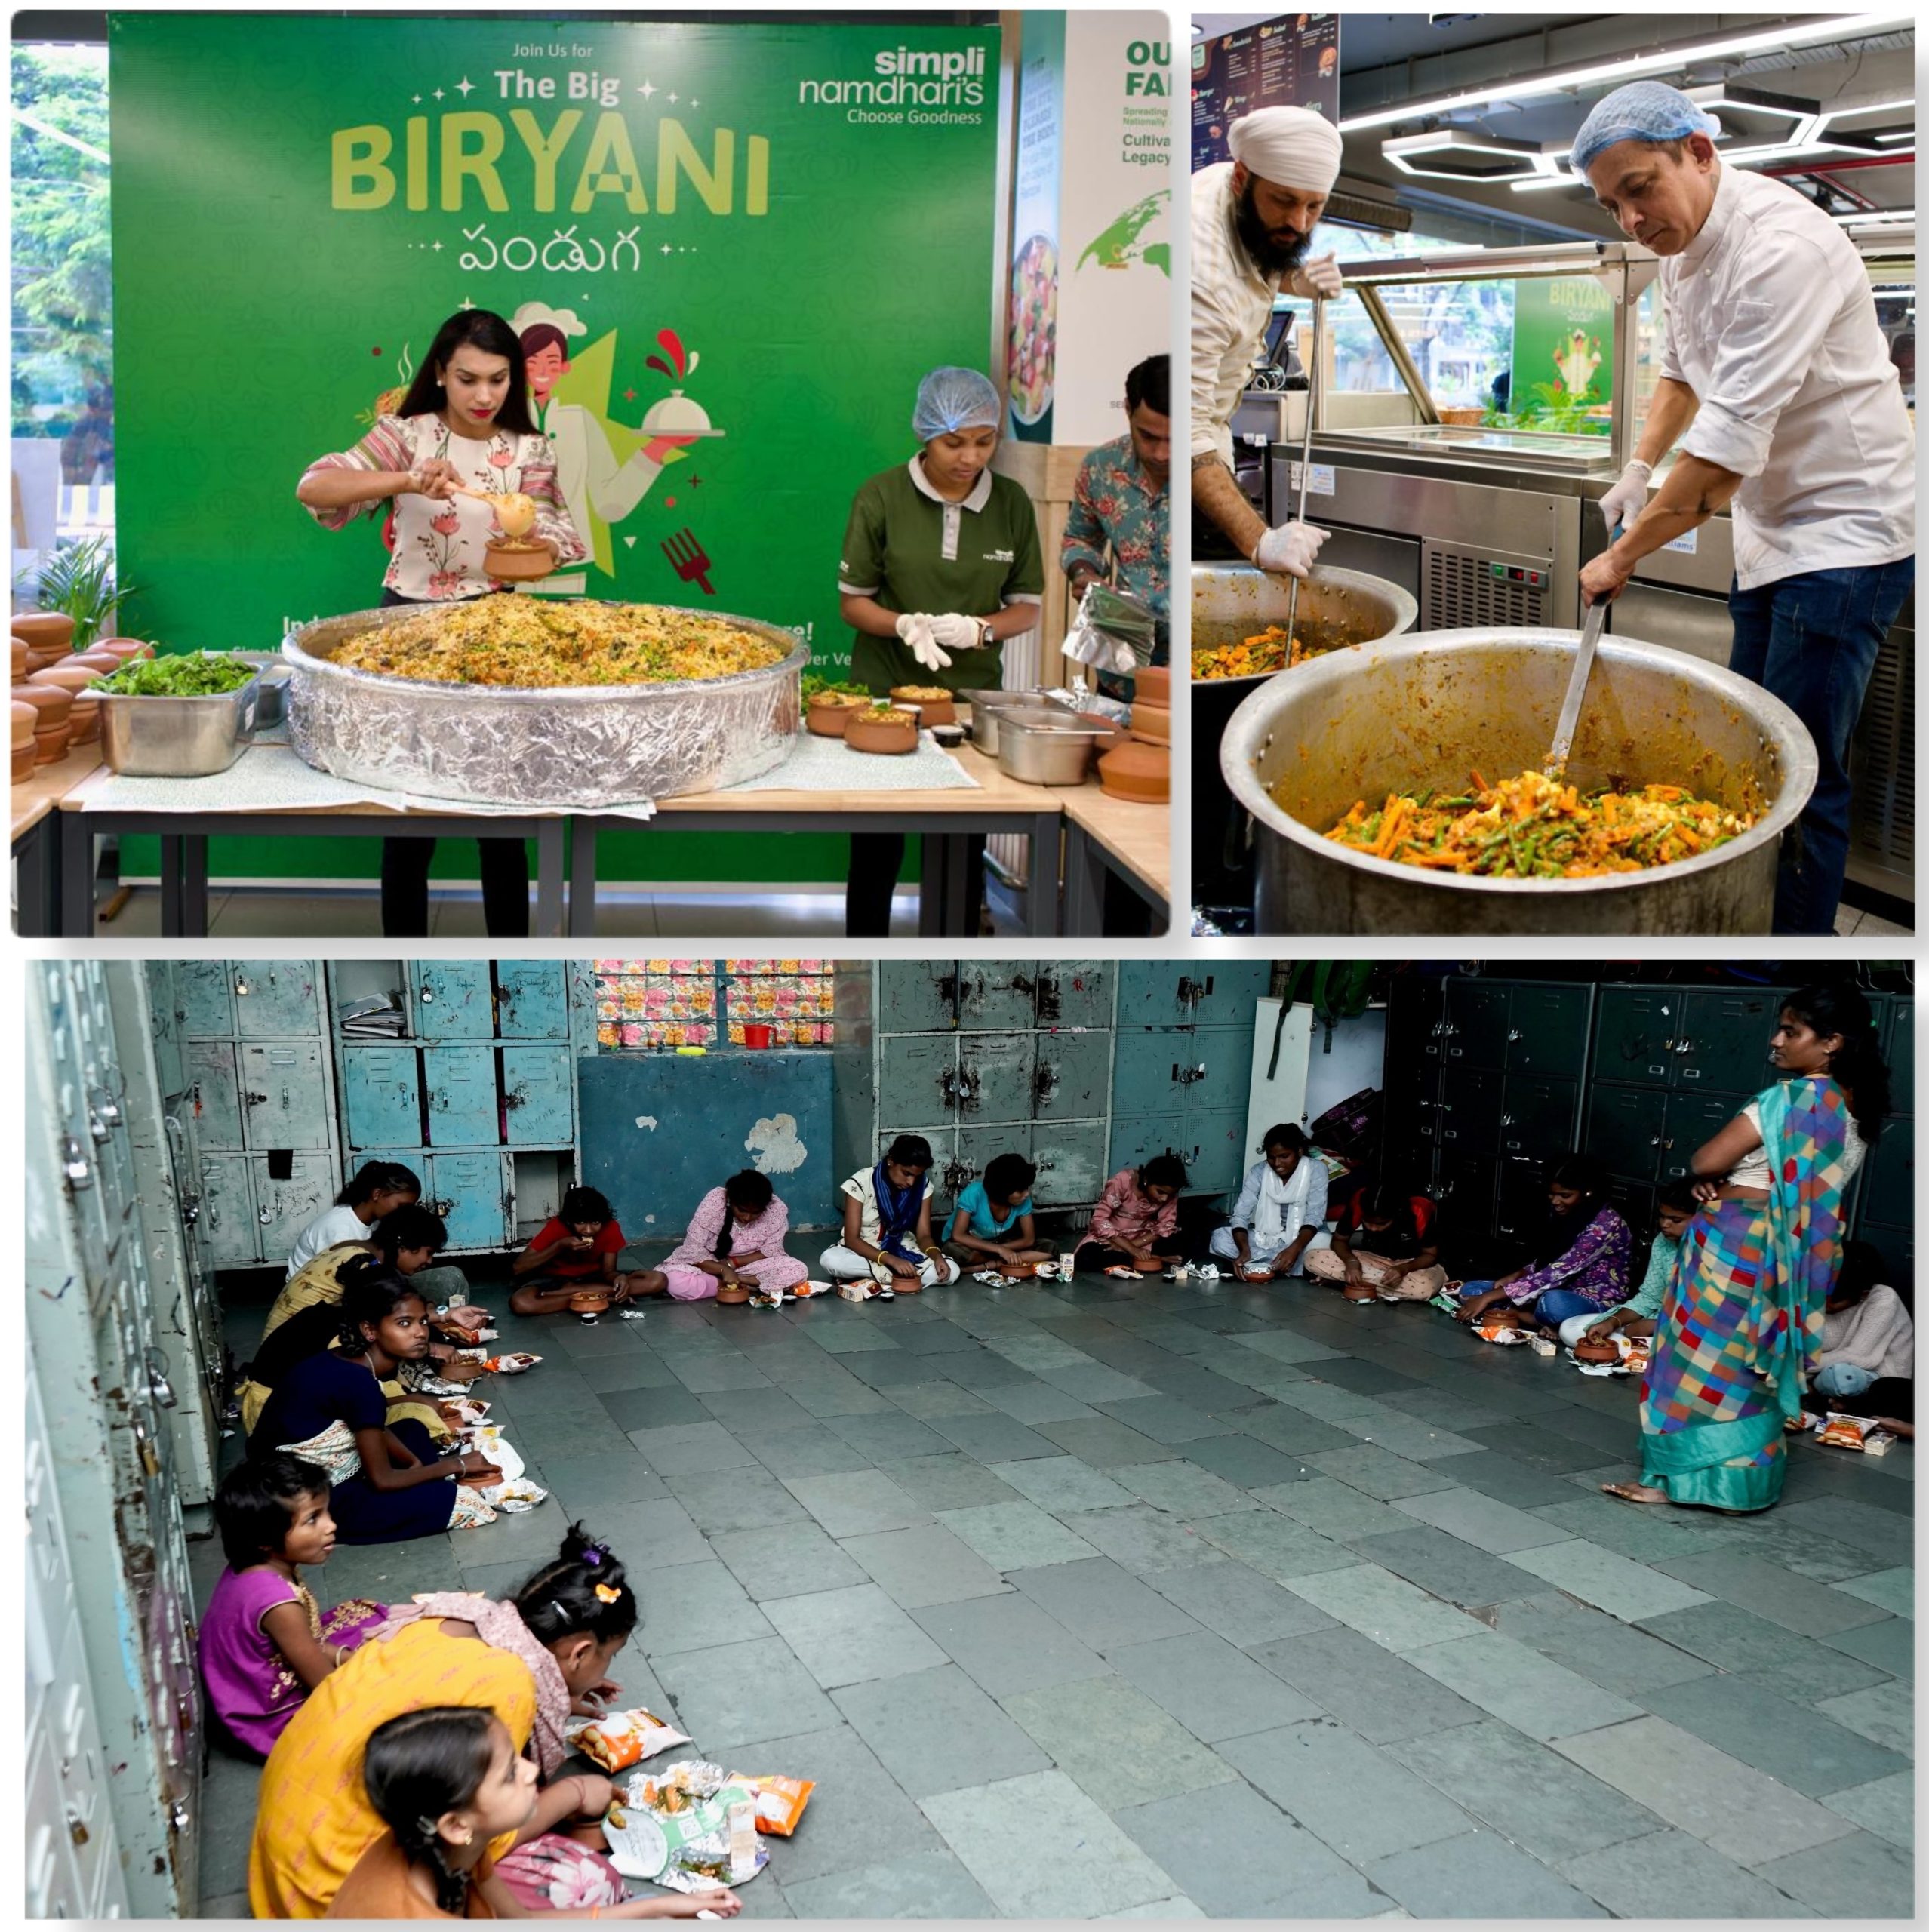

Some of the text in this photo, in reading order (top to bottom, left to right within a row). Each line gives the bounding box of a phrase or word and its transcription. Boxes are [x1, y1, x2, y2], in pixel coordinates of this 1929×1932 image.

[512, 43, 594, 57] Join Us for
[875, 46, 985, 82] simpli
[494, 69, 620, 106] The Big
[799, 77, 984, 106] namdhari's
[1126, 72, 1171, 96] FA
[847, 109, 983, 125] Choose Goodness
[331, 109, 769, 216] BIRYANI
[1122, 151, 1171, 165] Legacy
[459, 223, 641, 272] పండుగ
